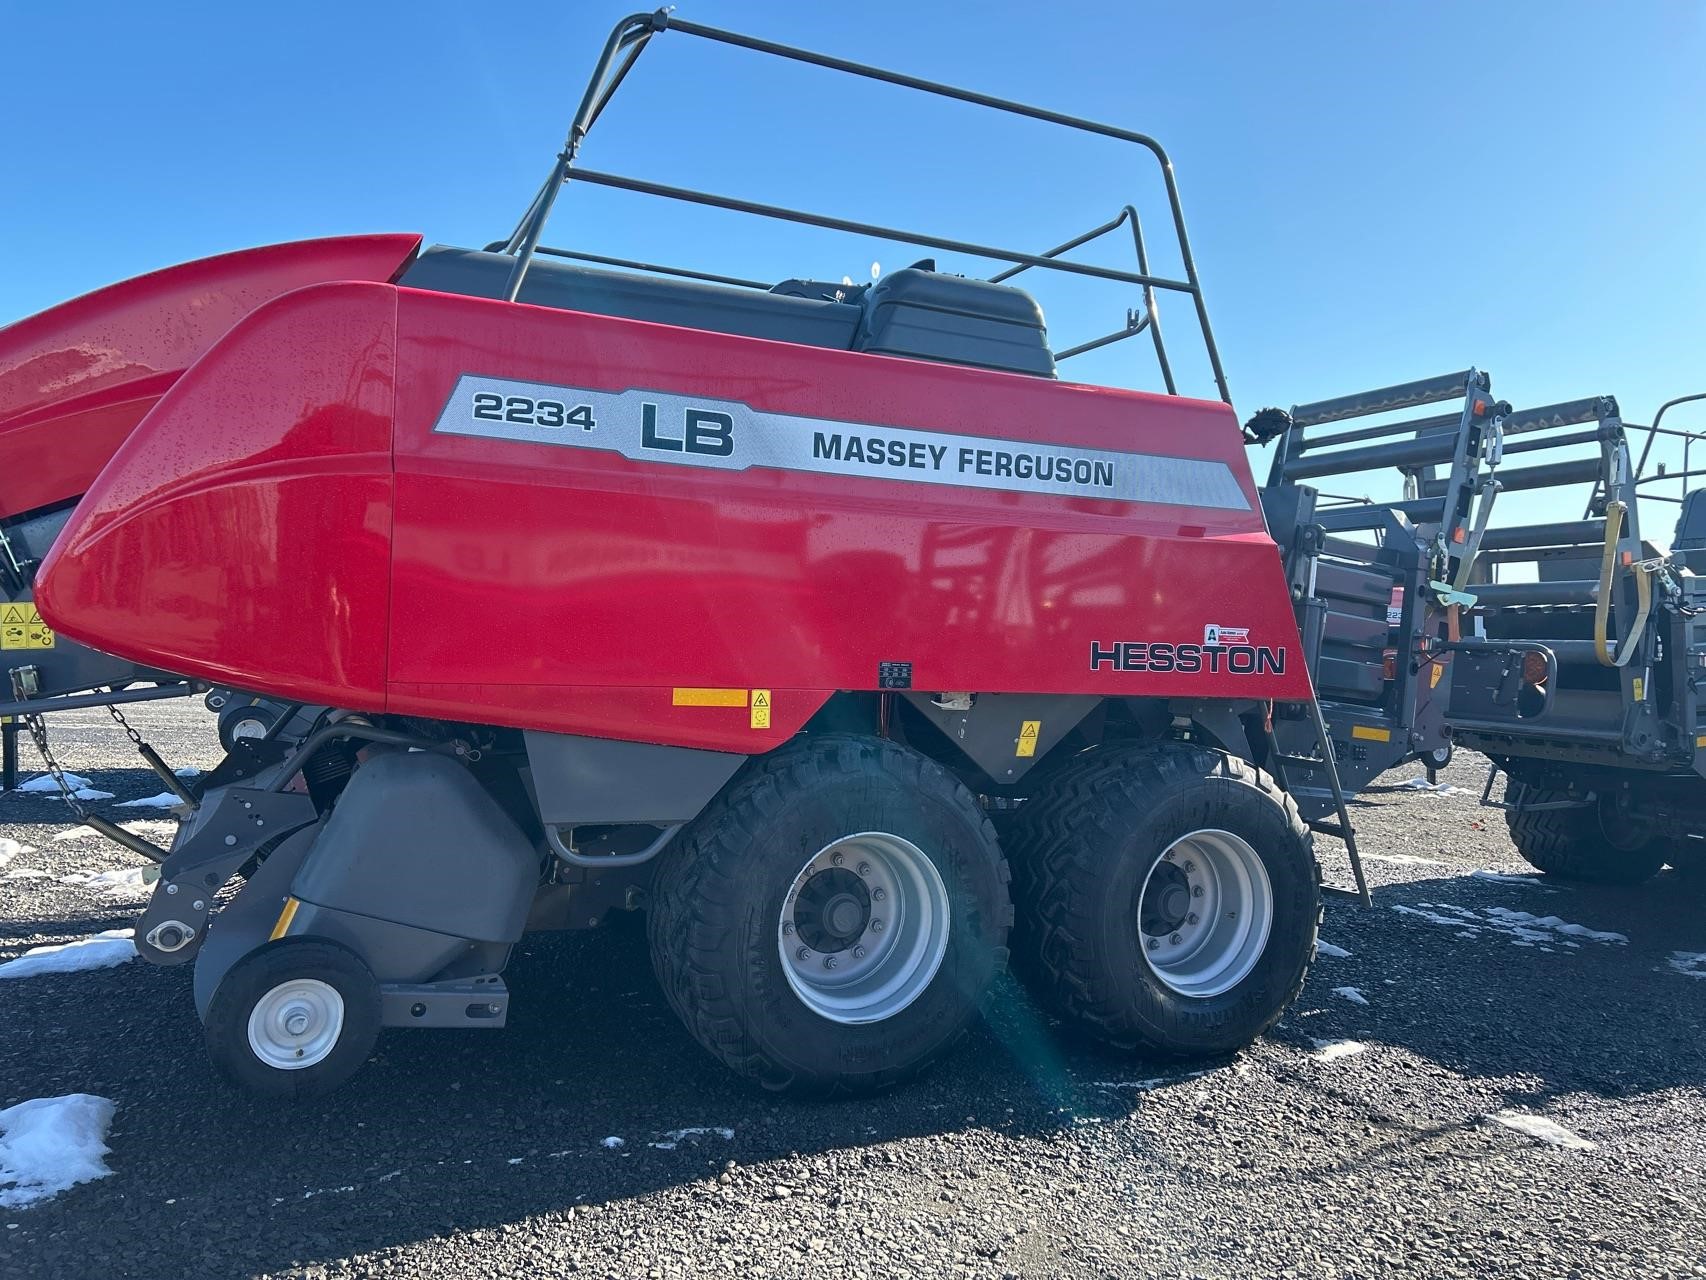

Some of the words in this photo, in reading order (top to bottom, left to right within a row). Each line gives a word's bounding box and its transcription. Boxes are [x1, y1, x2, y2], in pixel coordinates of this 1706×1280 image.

[473, 393, 597, 431] 2234
[640, 403, 735, 457] LB
[813, 432, 947, 470] MASSEY
[958, 448, 1114, 487] FERGUSON
[1090, 641, 1286, 675] HESSTON
